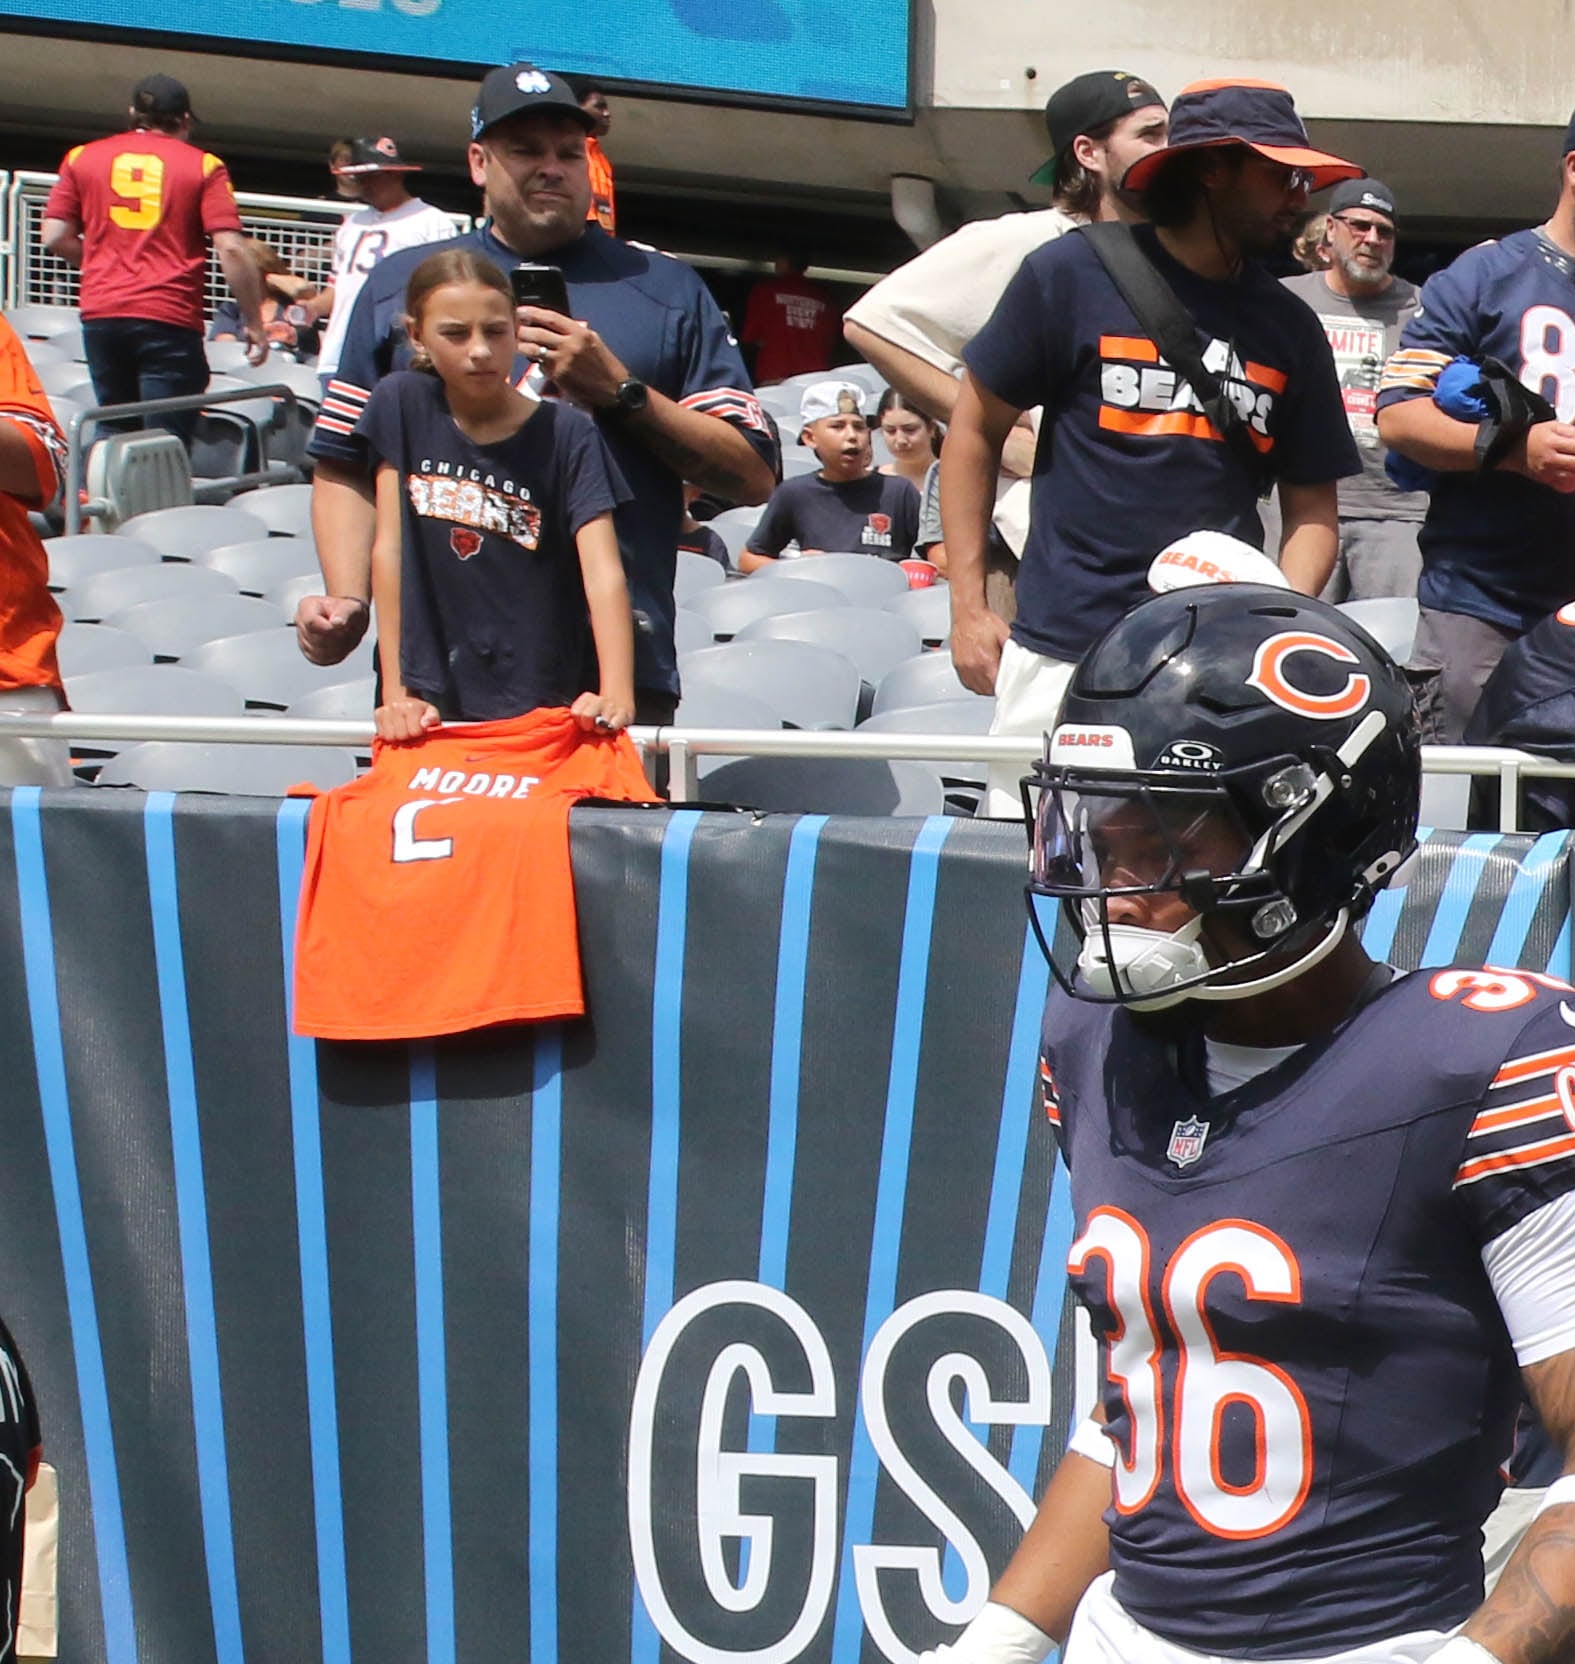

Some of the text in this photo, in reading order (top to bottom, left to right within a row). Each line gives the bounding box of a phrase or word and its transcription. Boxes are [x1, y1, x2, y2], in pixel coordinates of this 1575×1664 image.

[109, 152, 164, 231] 9
[1101, 362, 1274, 435] BEARS
[420, 459, 531, 501] CHICAGO
[1245, 631, 1371, 720] C
[1058, 733, 1113, 747] BEARS
[1161, 755, 1223, 770] OAKLEY
[408, 767, 541, 799] MOORE
[1067, 1205, 1314, 1540] 36
